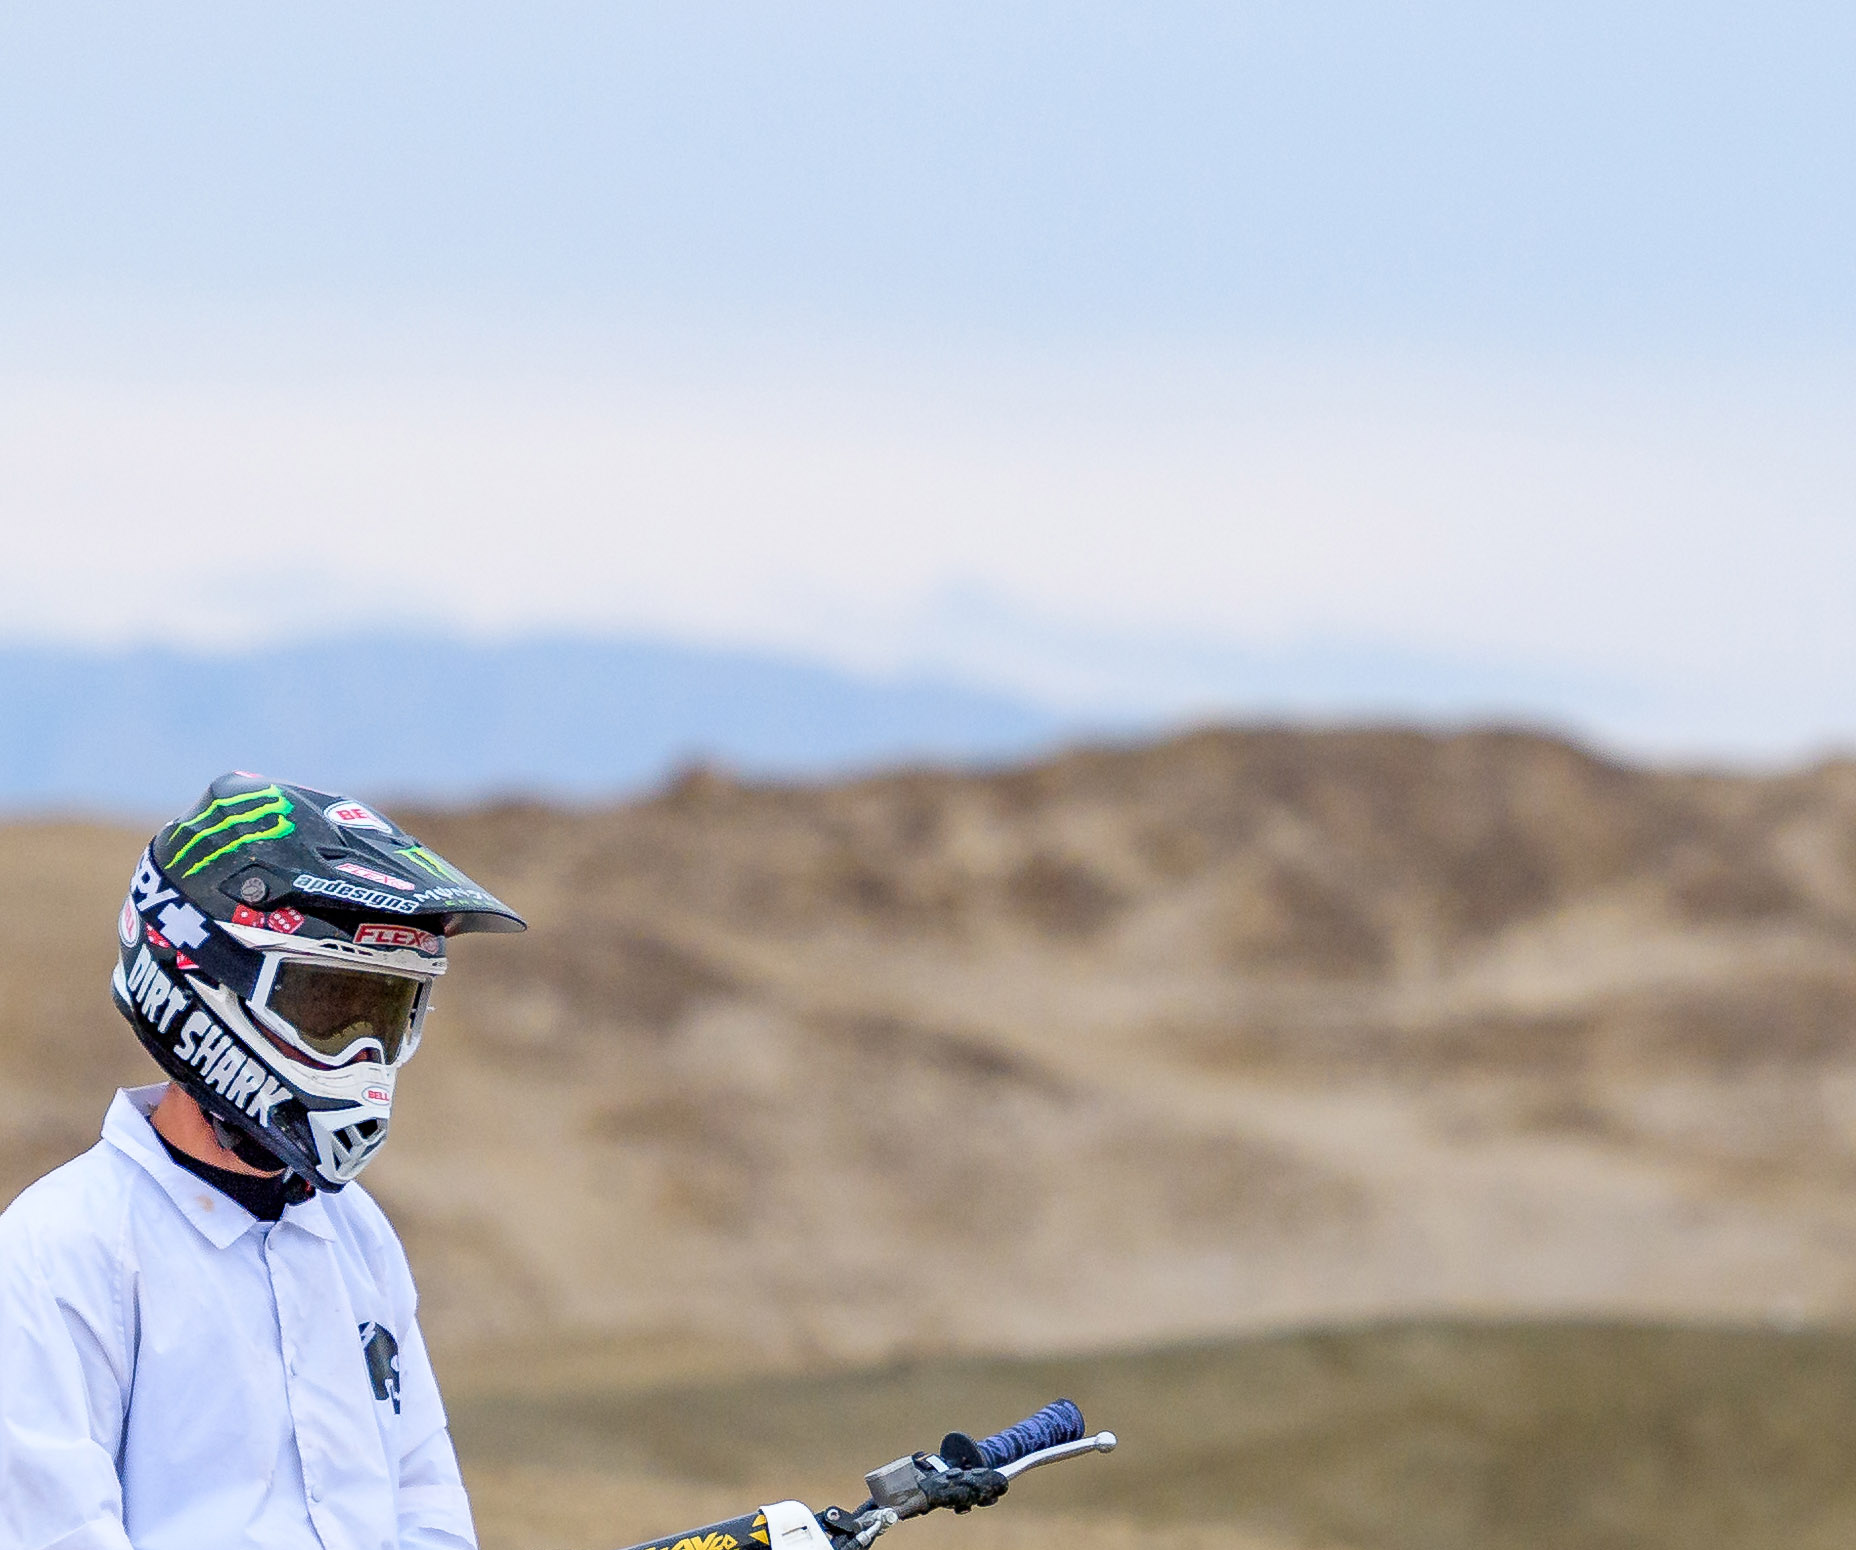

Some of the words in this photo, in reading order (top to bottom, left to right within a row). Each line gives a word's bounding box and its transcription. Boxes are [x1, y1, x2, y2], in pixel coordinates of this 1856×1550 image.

[292, 874, 420, 914] apdesigns
[355, 924, 421, 946] FLEX
[127, 943, 190, 1034] DIRT
[173, 1011, 293, 1128] SHARK
